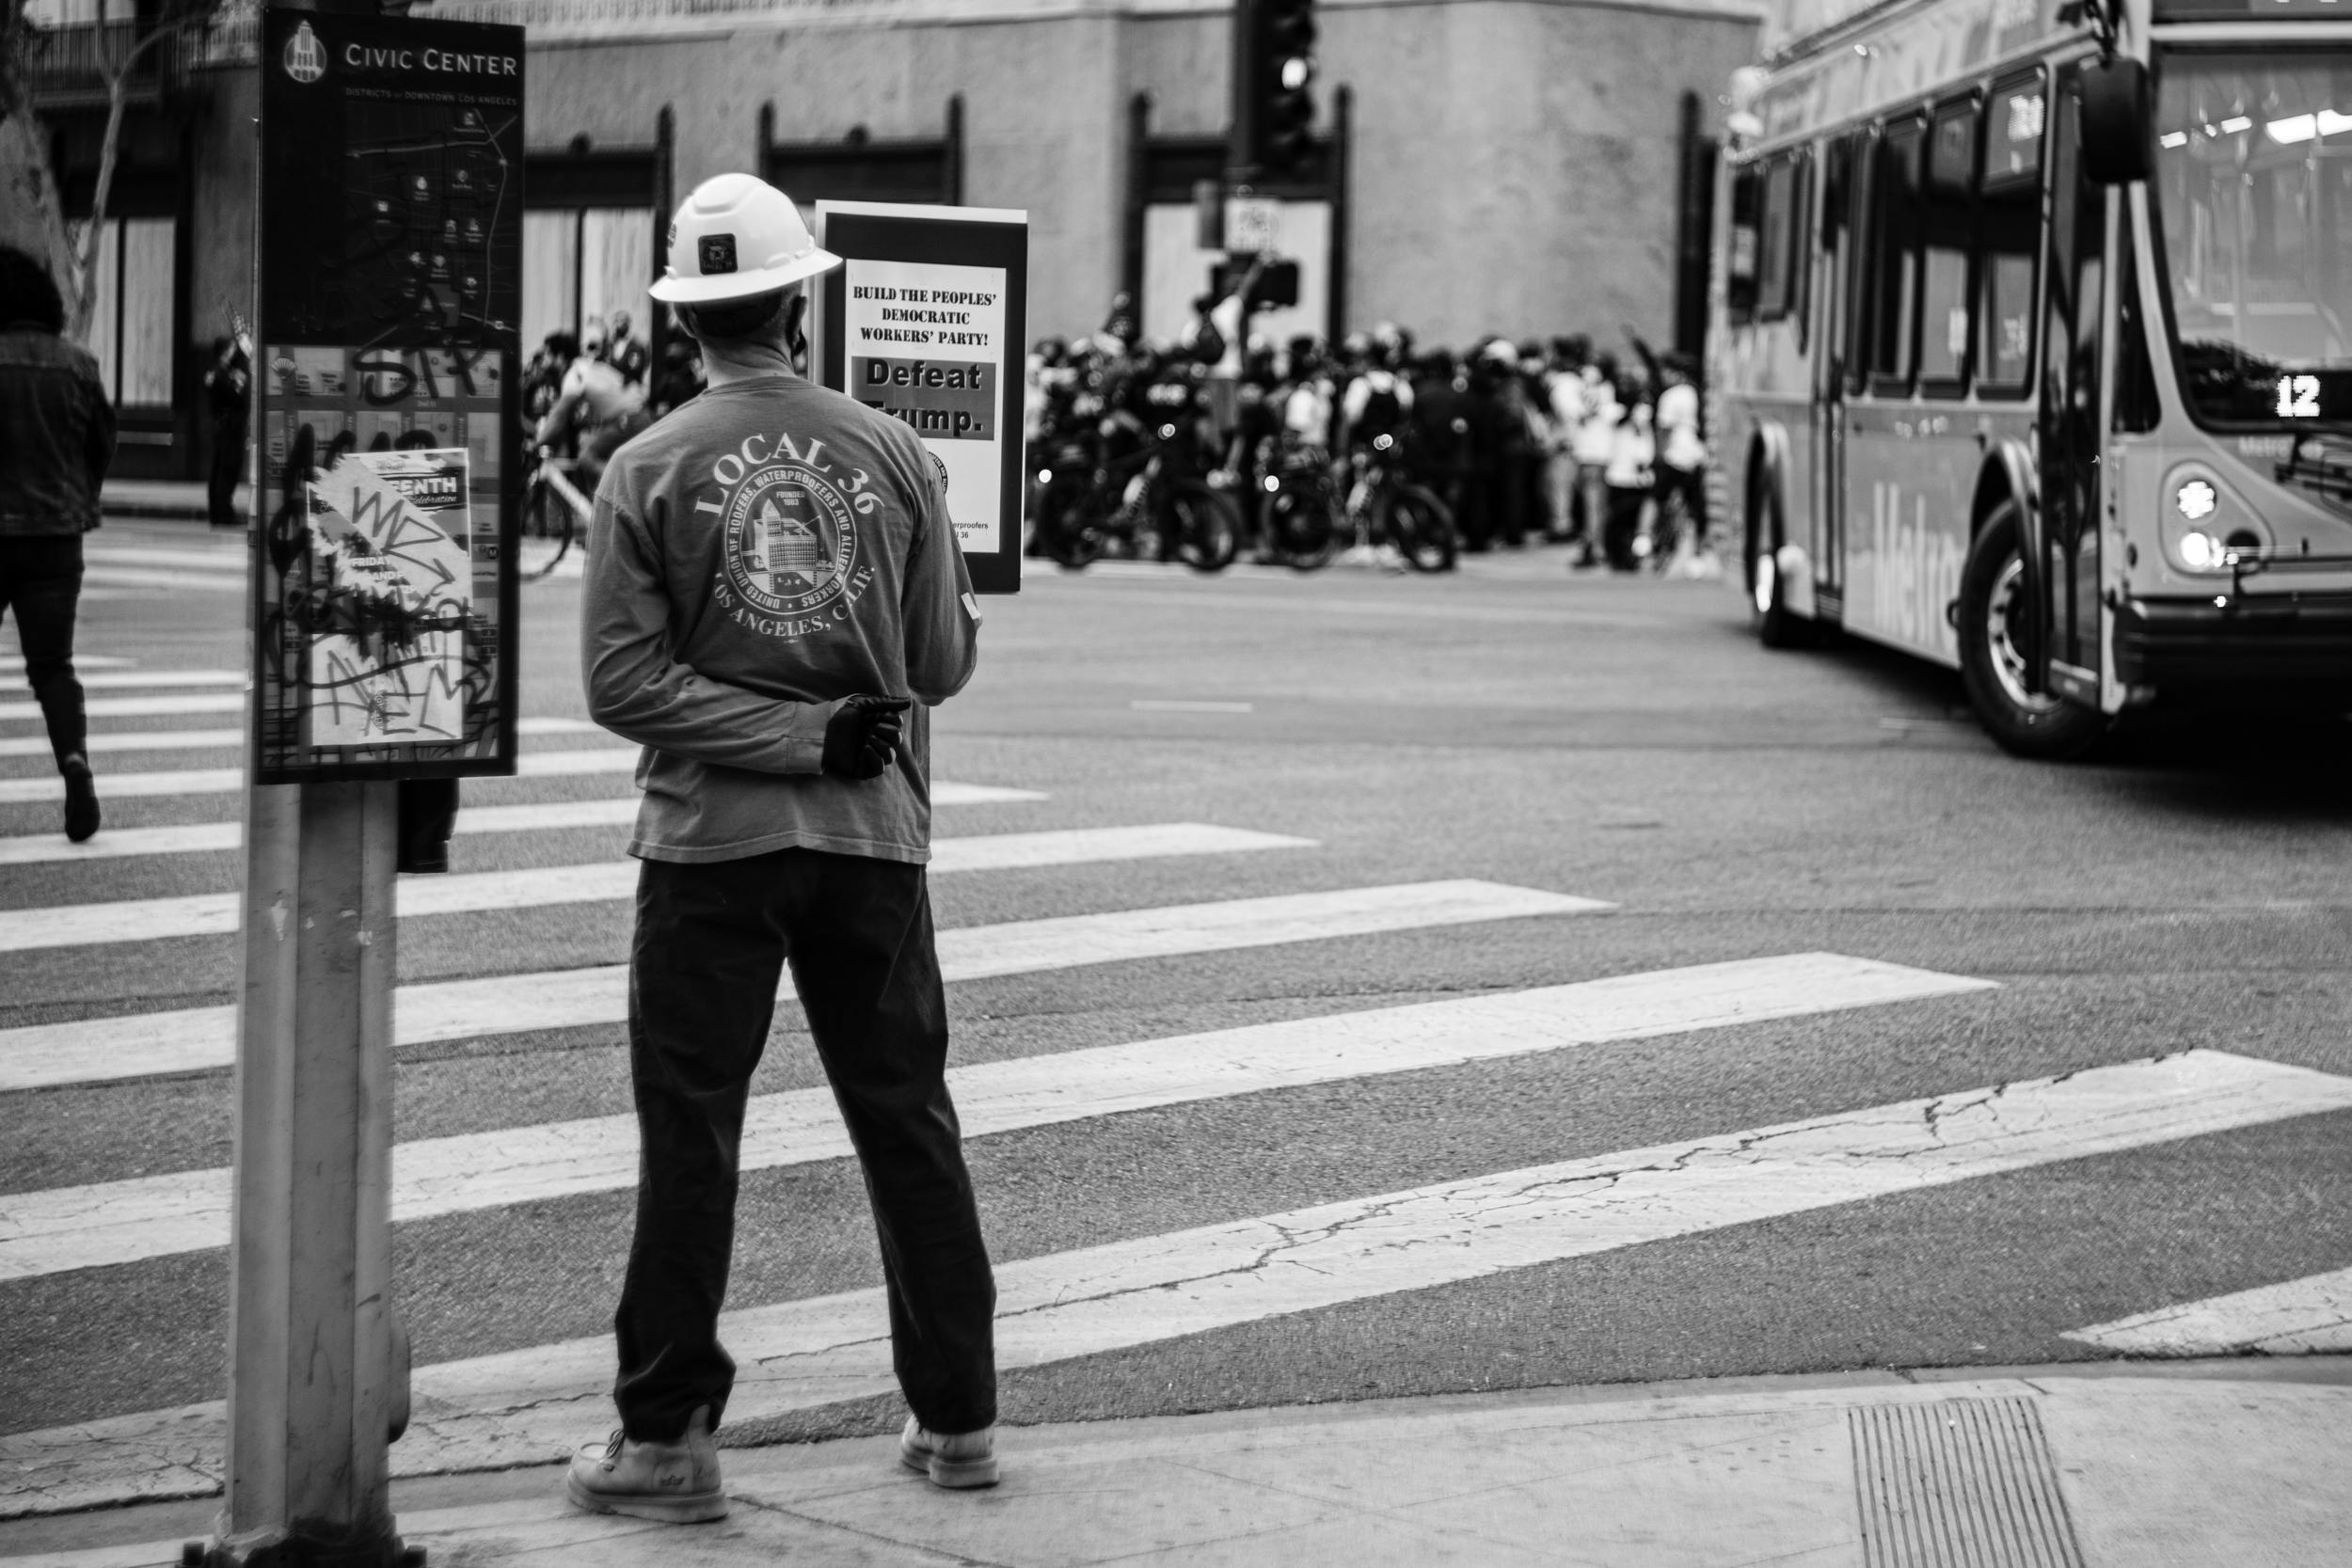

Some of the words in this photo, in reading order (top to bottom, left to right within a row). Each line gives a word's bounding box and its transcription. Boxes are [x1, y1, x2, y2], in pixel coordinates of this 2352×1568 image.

[344, 43, 412, 70] CIVIC
[423, 48, 516, 76] CENTER
[345, 87, 392, 99] DISTRICTS
[405, 90, 455, 103] DOWNTOWN
[459, 95, 475, 103] LOS
[478, 96, 517, 106] ANGELES
[853, 285, 897, 300] BUILD
[899, 289, 929, 303] THE
[882, 308, 970, 325] DEMOCRATIC
[938, 331, 989, 346] PARTY!
[866, 357, 982, 390] Defeat
[2276, 374, 2321, 417] 12
[693, 432, 832, 517] LOCAL
[837, 467, 885, 515] 36
[754, 469, 839, 508] WATERPROOFERS
[775, 490, 806, 499] FOUNDED
[834, 509, 850, 531] AND
[952, 521, 989, 530] erproofers
[729, 538, 738, 553] OF
[838, 534, 852, 572] ALLIED
[729, 556, 749, 588] UNION
[715, 572, 736, 609] OS
[730, 608, 832, 637] ANGELES,
[832, 565, 876, 621] CLIF.
[745, 585, 780, 610] UNITED
[801, 572, 844, 608] WORKERS
